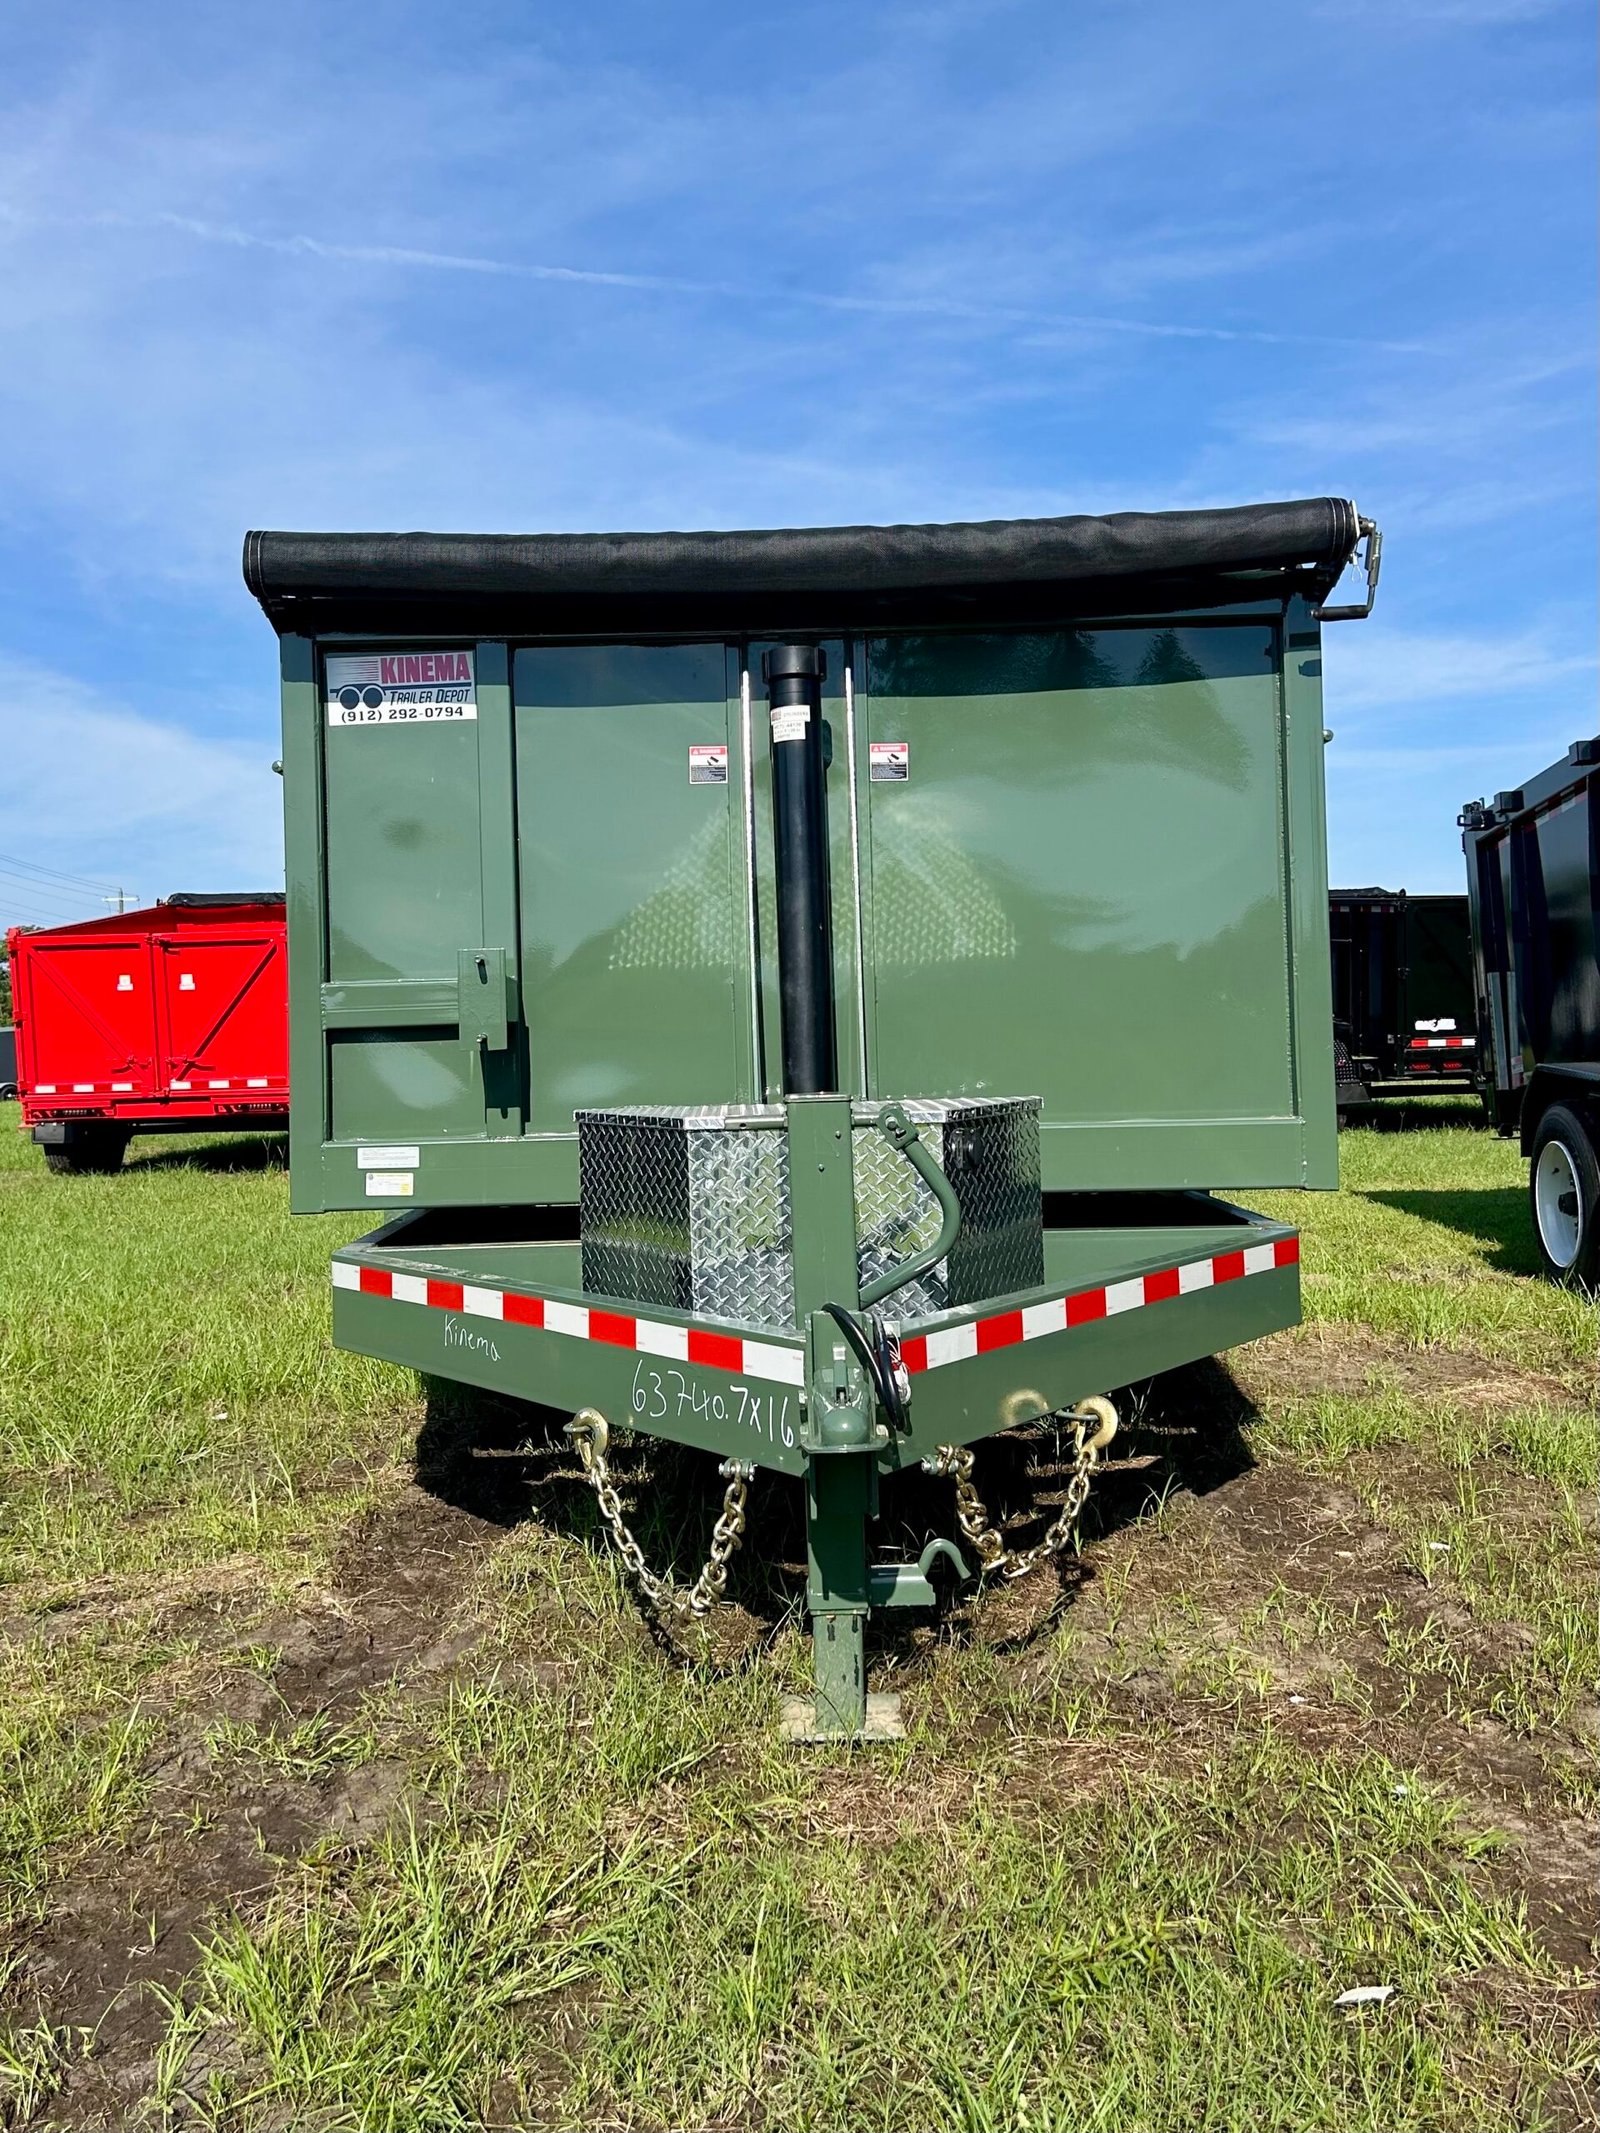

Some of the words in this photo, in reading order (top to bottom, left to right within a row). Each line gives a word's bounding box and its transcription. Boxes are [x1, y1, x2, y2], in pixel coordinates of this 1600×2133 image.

[380, 654, 471, 684] KINEMA
[390, 690, 433, 706] TRAILER
[435, 689, 471, 704] DEPOT
[341, 710, 383, 723] (912)
[389, 706, 463, 720] 292-0794
[444, 1314, 501, 1361] Kinema
